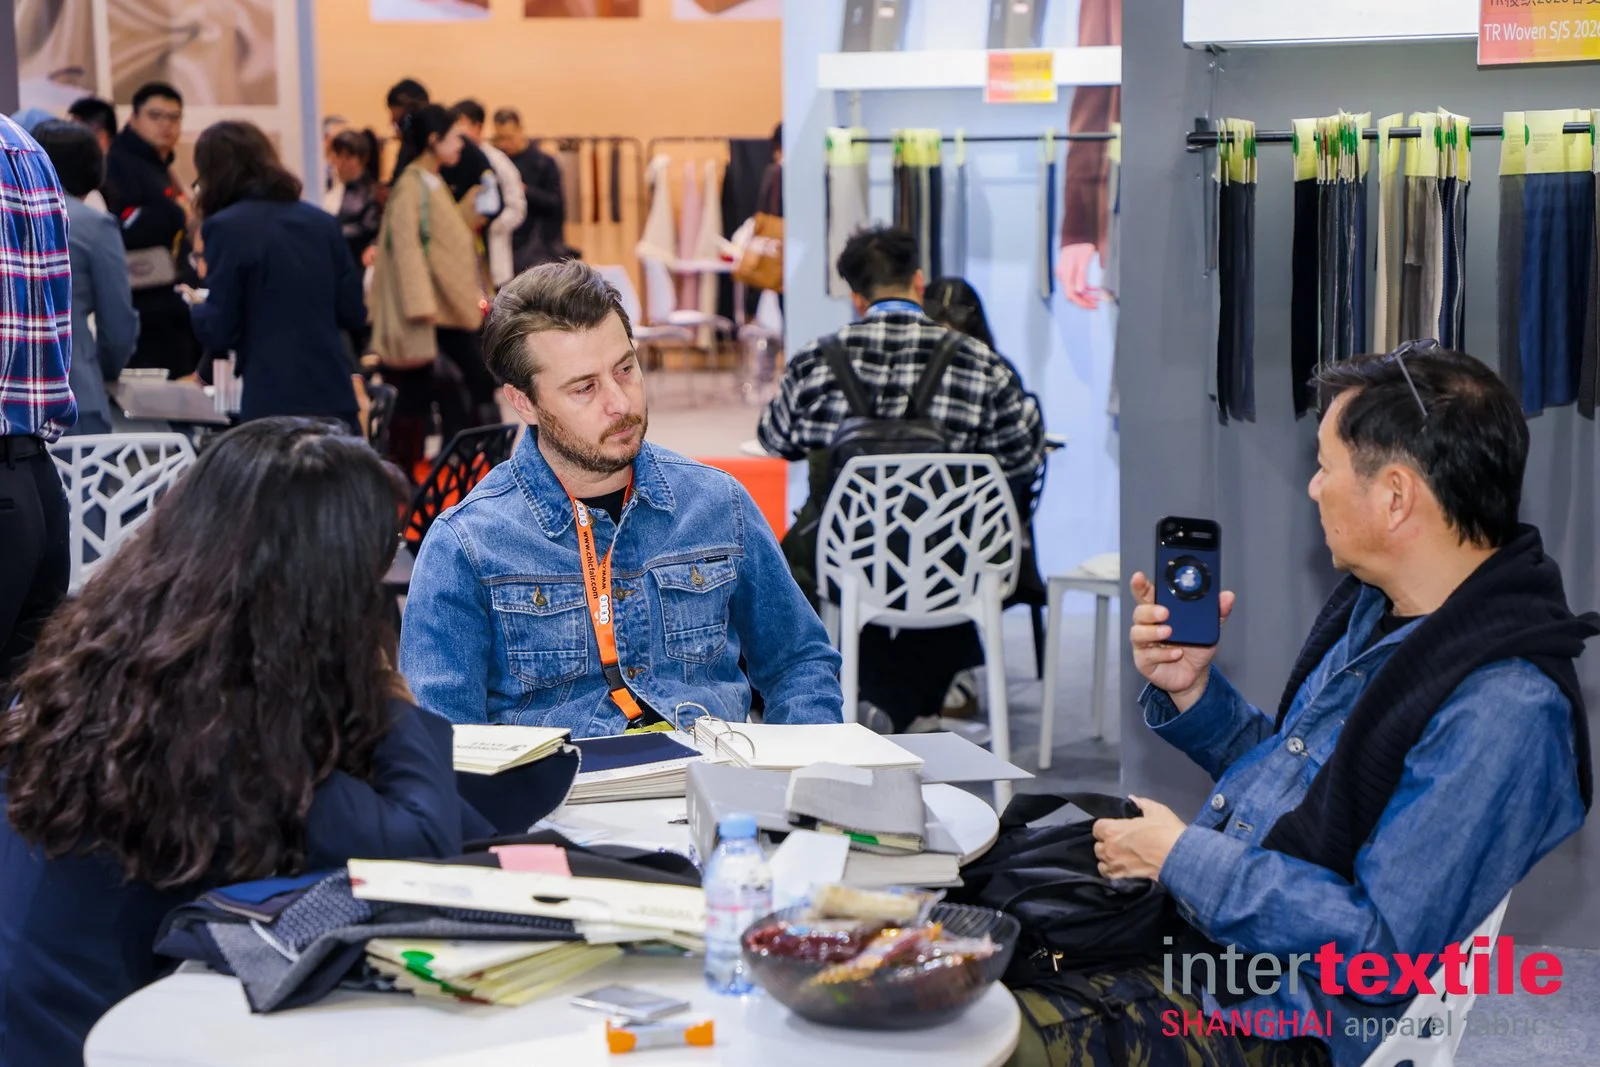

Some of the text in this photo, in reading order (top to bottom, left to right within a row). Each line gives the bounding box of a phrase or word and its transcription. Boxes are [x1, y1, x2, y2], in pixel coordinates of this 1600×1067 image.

[1484, 23, 1500, 41] TR
[1503, 22, 1546, 40] Woven
[1549, 20, 1570, 43] S/S
[583, 531, 598, 599] www.chicfair.com
